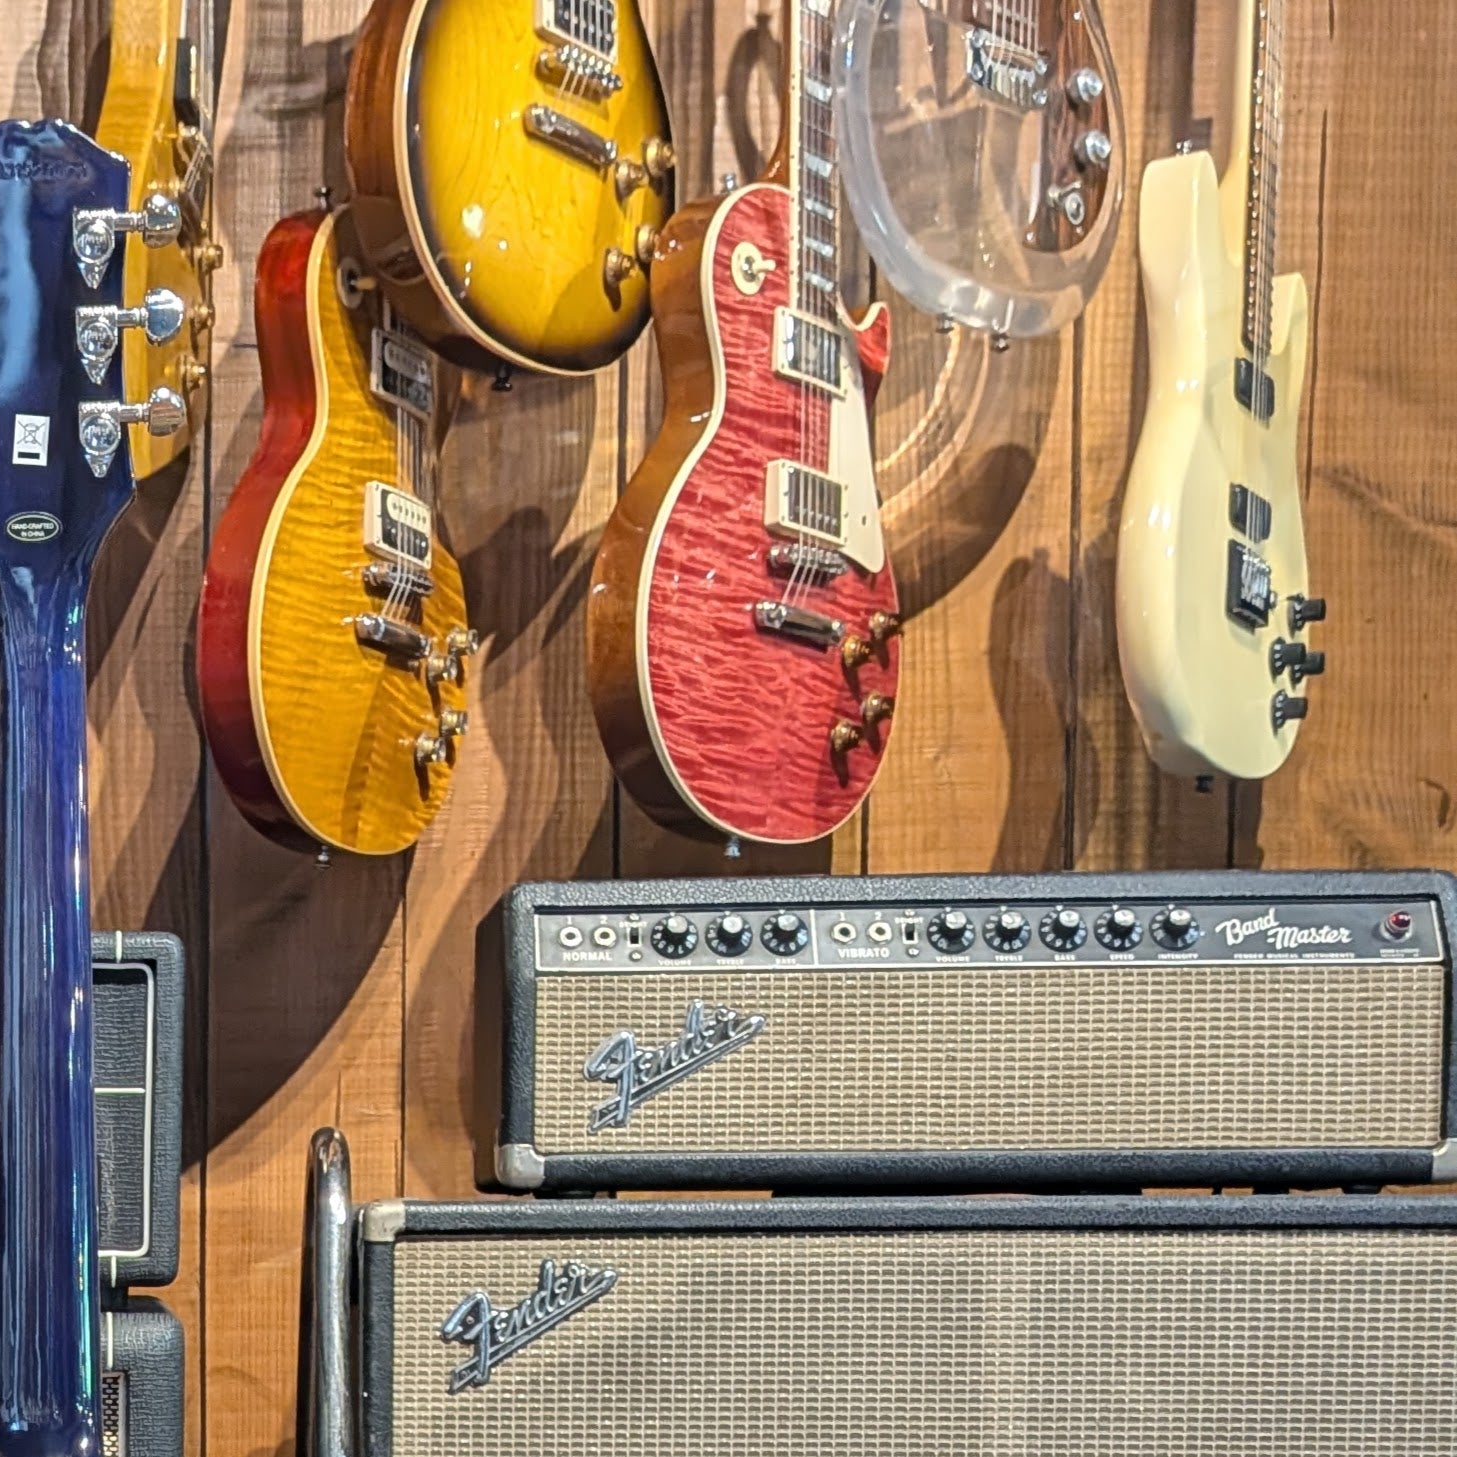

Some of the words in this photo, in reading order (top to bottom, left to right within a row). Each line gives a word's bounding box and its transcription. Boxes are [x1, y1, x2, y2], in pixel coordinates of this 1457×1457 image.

[839, 911, 846, 921] 1
[874, 911, 882, 921] 2
[1215, 907, 1280, 946] Band
[562, 951, 613, 961] NORMAL
[837, 947, 891, 959] VIBRATO
[584, 998, 767, 1136] Fender
[440, 1258, 618, 1395] Fender
